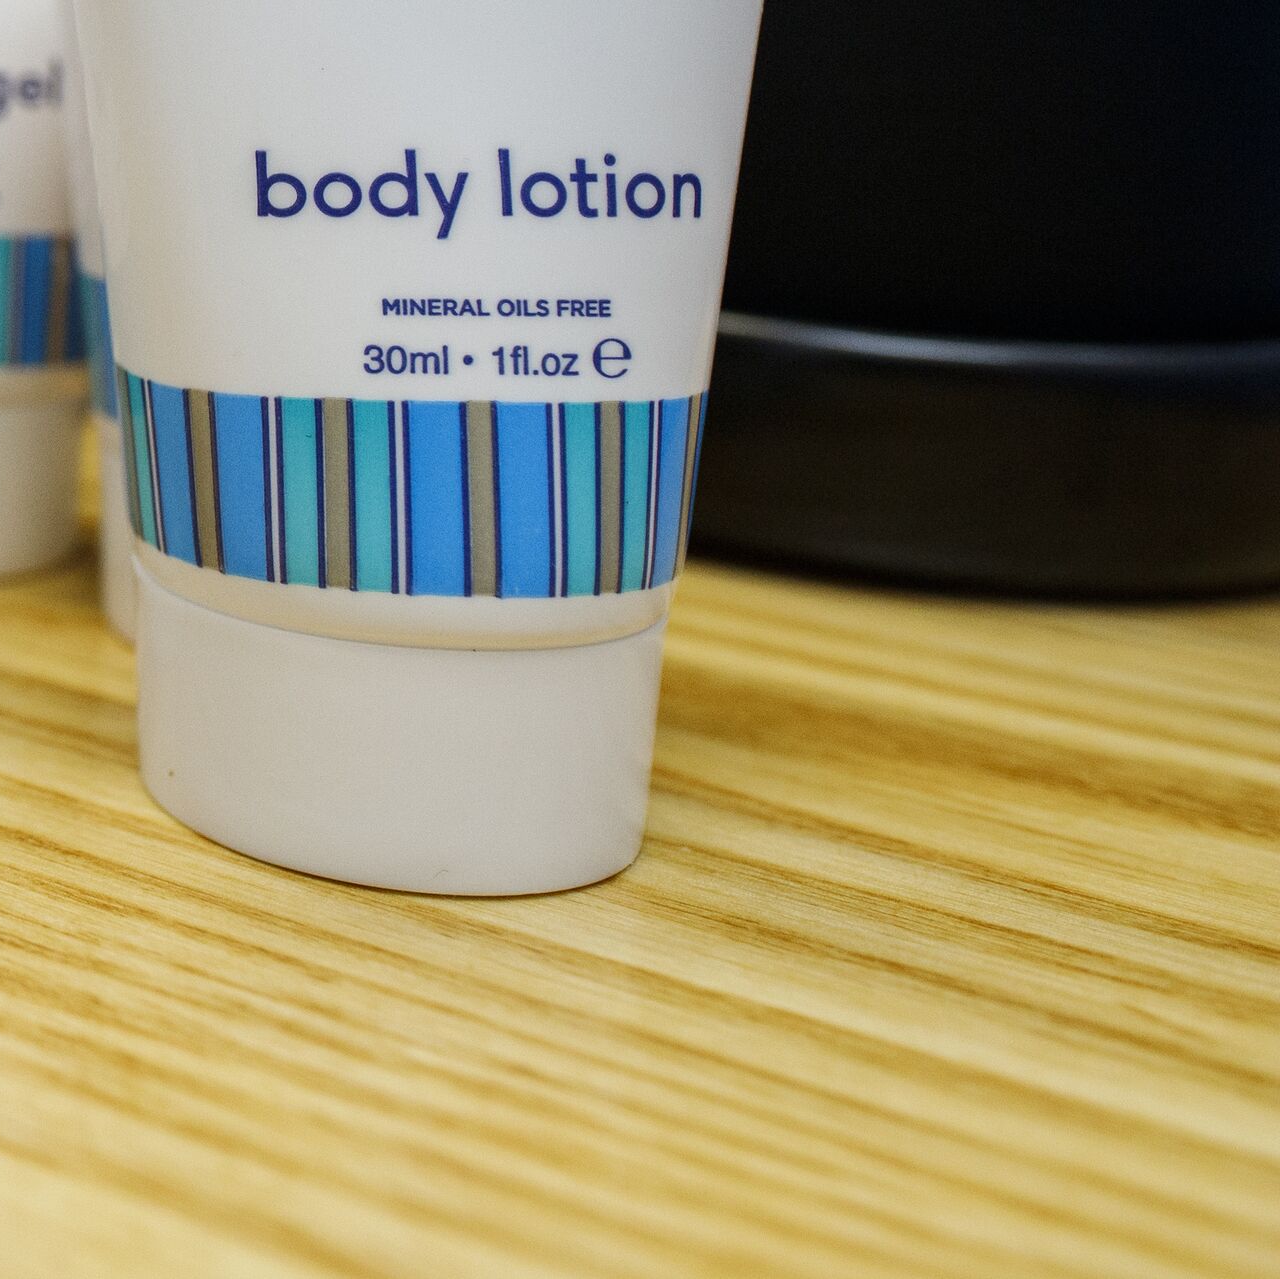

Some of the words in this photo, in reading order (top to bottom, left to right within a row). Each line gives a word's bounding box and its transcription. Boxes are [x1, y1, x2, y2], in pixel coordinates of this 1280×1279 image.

[254, 148, 471, 241] body
[497, 147, 703, 220] lotion
[381, 297, 491, 319] MINERAL
[496, 298, 551, 319] OILS
[556, 298, 613, 319] FREE
[362, 343, 451, 376] 30ml
[491, 344, 580, 378] 1fl.oz
